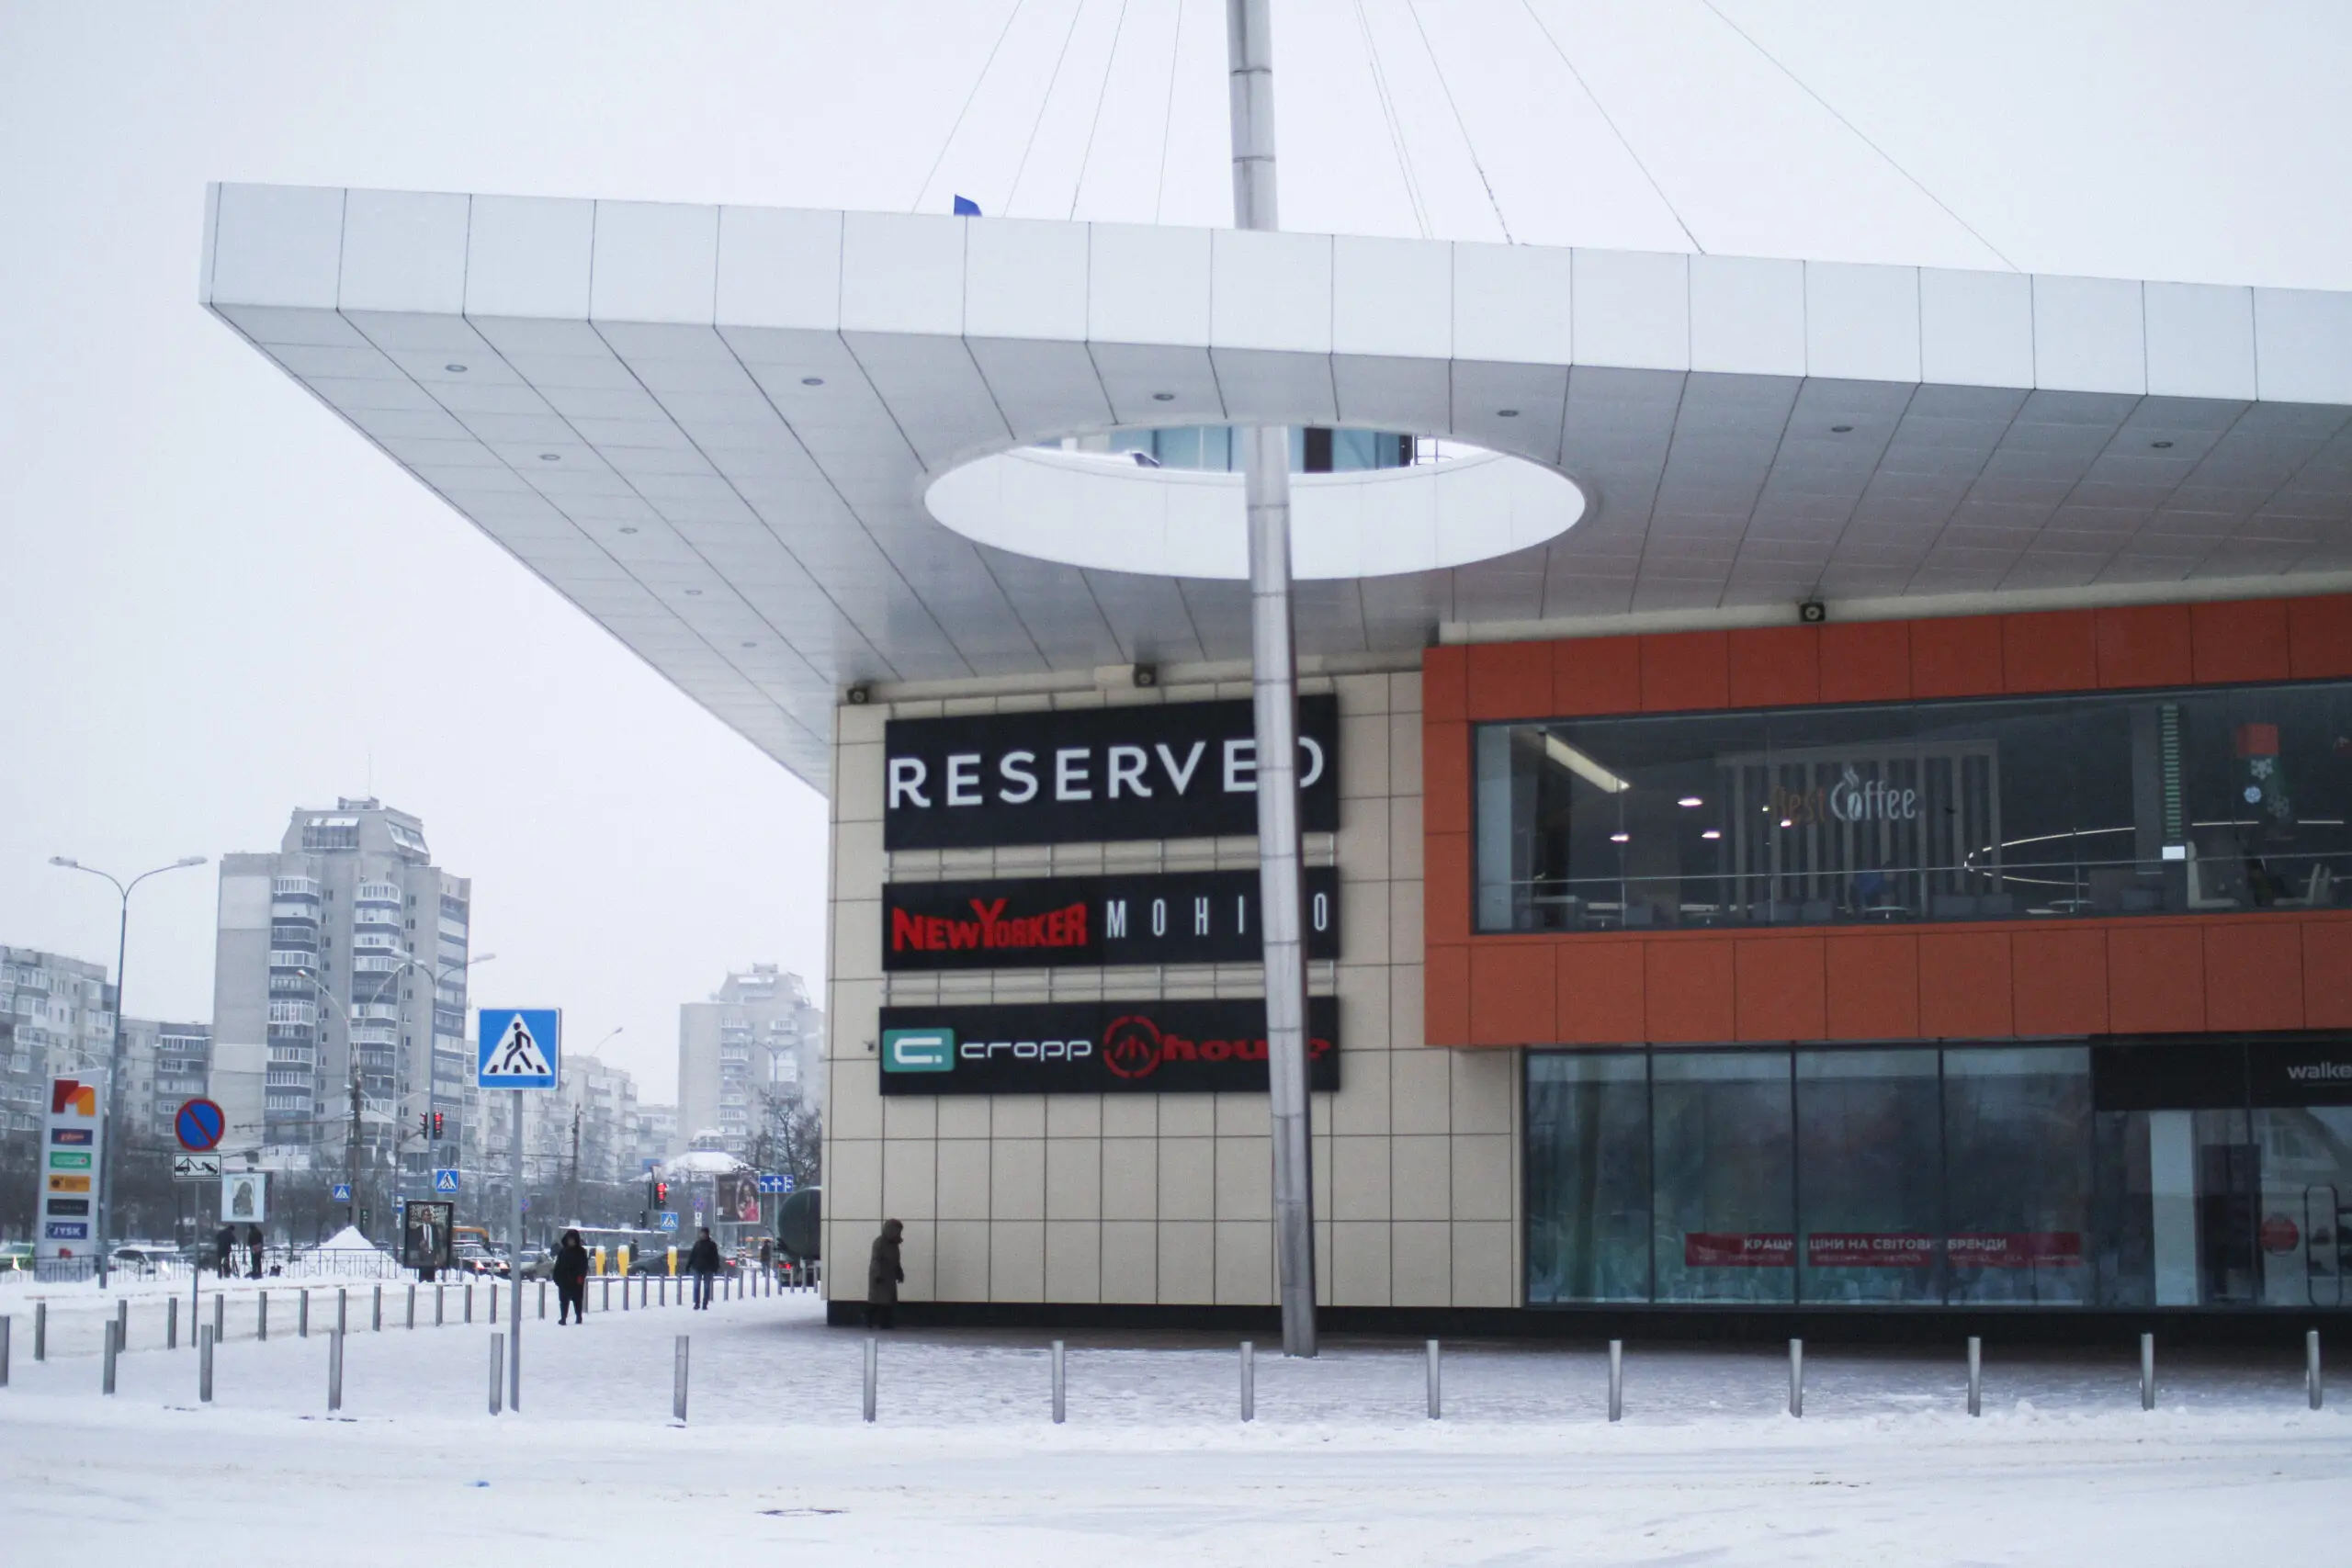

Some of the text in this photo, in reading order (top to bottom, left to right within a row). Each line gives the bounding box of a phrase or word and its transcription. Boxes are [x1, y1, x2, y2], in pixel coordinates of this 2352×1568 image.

[1830, 780, 1917, 821] Coffee
[1107, 892, 1329, 938] MOHIO
[960, 1039, 1091, 1062] cropp
[1162, 1033, 1331, 1062] houe
[53, 1225, 81, 1236] JYSK
[1810, 1238, 1844, 1251] ЦІНИ
[1849, 1238, 1869, 1249] НА
[1947, 1237, 2007, 1251] БРЕНДИ
